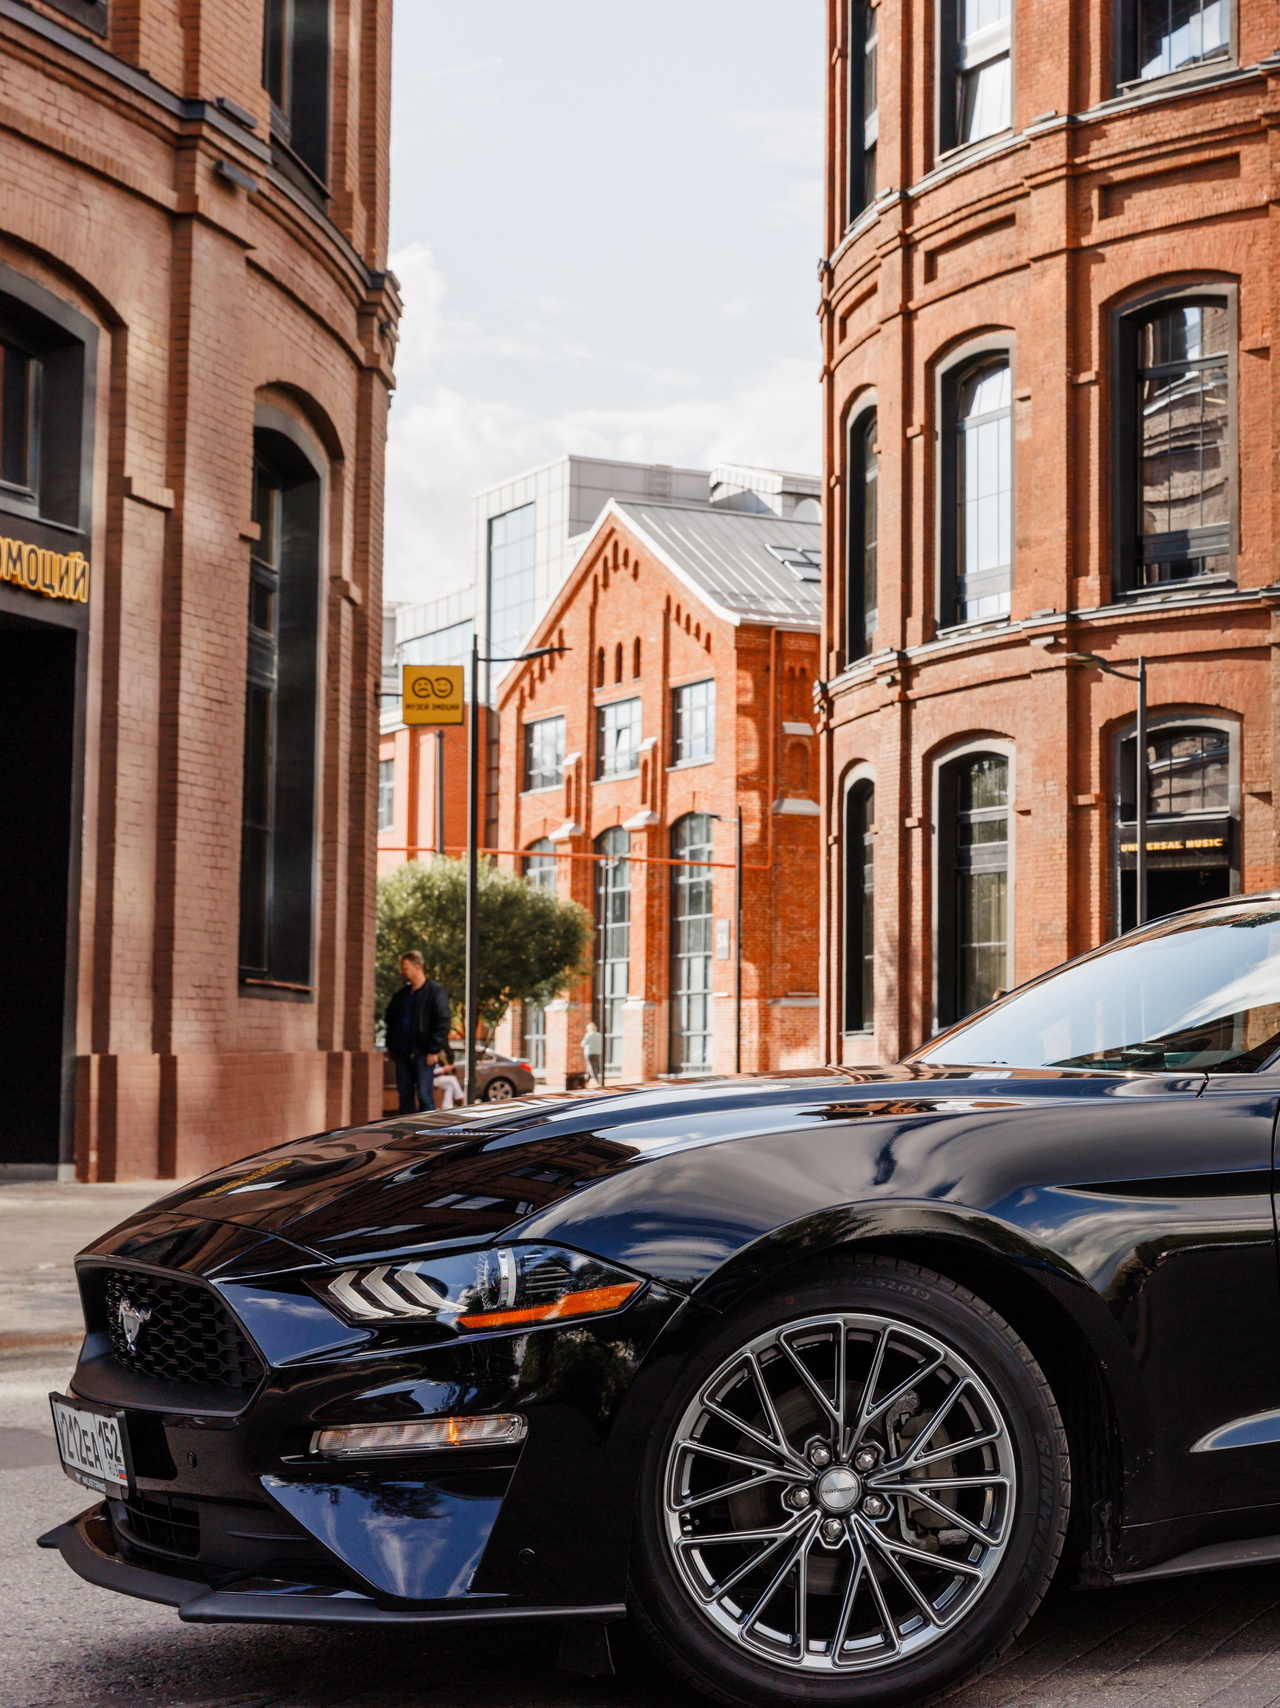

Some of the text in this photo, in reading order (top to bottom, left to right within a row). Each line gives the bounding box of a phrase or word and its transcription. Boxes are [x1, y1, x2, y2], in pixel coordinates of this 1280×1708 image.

[0, 535, 90, 604] МОЦИЙ
[1120, 838, 1224, 853] UNIERSAL MUSIC
[97, 1419, 122, 1464] 152
[82, 1475, 107, 1492] MUSTANG
[821, 1486, 857, 1495] VOSSEN
